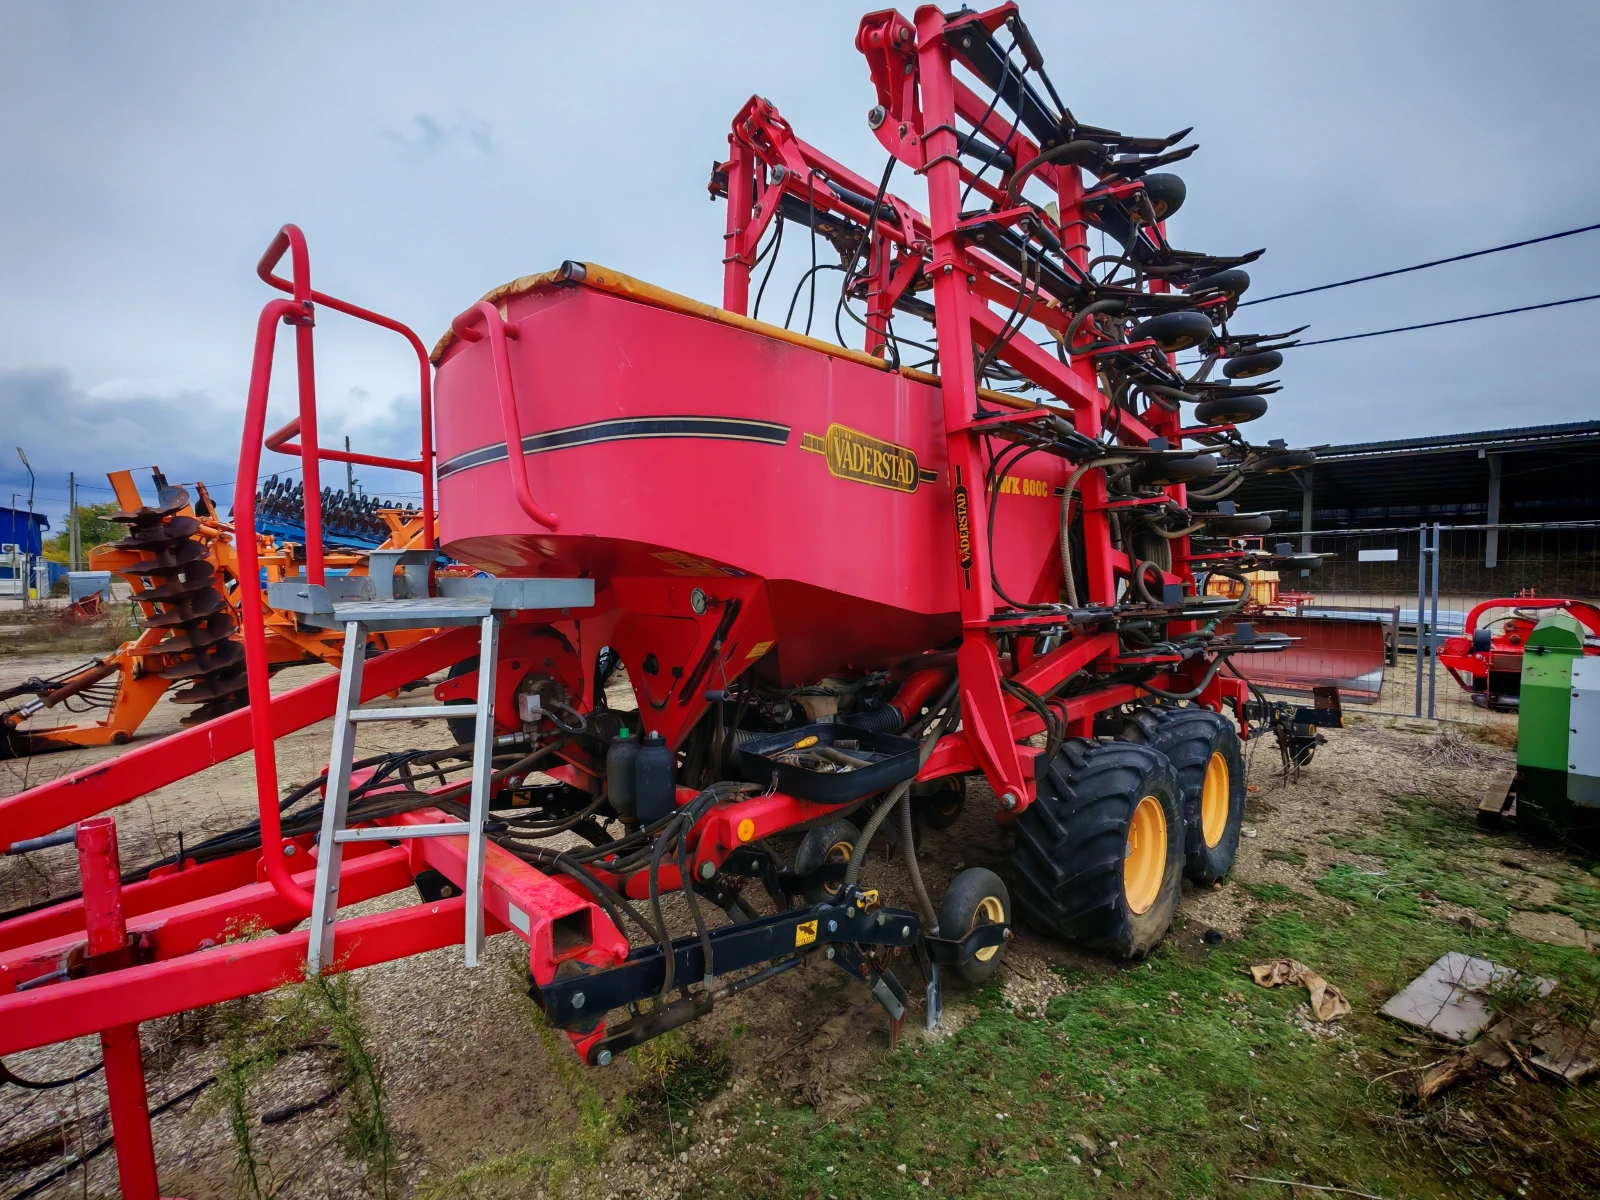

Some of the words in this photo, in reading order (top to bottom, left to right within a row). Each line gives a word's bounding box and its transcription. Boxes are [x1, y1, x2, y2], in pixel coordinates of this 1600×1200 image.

[833, 433, 915, 485] VÄDERSTAD
[986, 474, 1021, 495] WK
[1022, 478, 1048, 498] 800C
[956, 492, 971, 563] VÄDERSTAD
